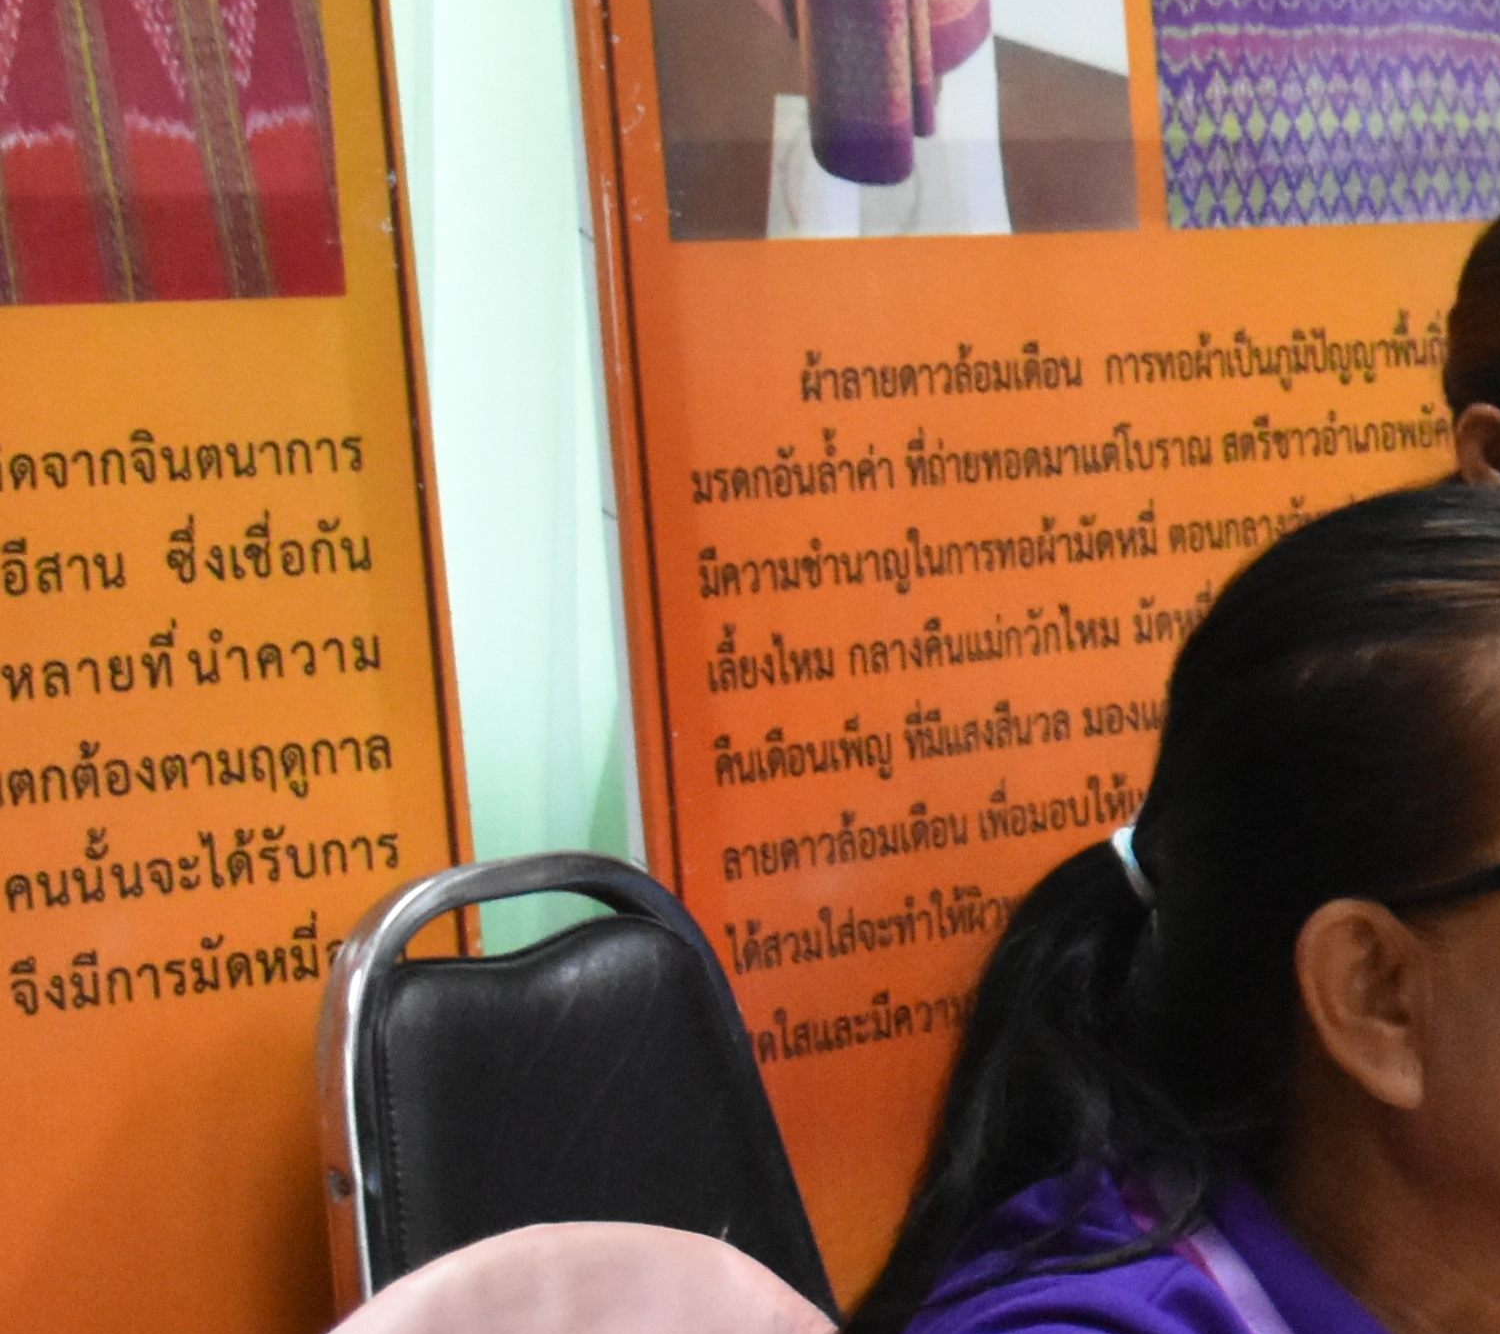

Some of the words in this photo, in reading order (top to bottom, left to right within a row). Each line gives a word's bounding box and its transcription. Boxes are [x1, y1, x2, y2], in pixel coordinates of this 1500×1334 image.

[0, 427, 365, 492] ดจากจินตนาการ
[691, 426, 896, 505] มรดกอันล้ำค่า
[1, 537, 127, 597] อีสาน
[707, 622, 837, 694] เลี้ยงไหม
[0, 732, 394, 809] ตกต้องตามฤดูกาล
[4, 826, 400, 913] คนนั้นจะได้รับการ
